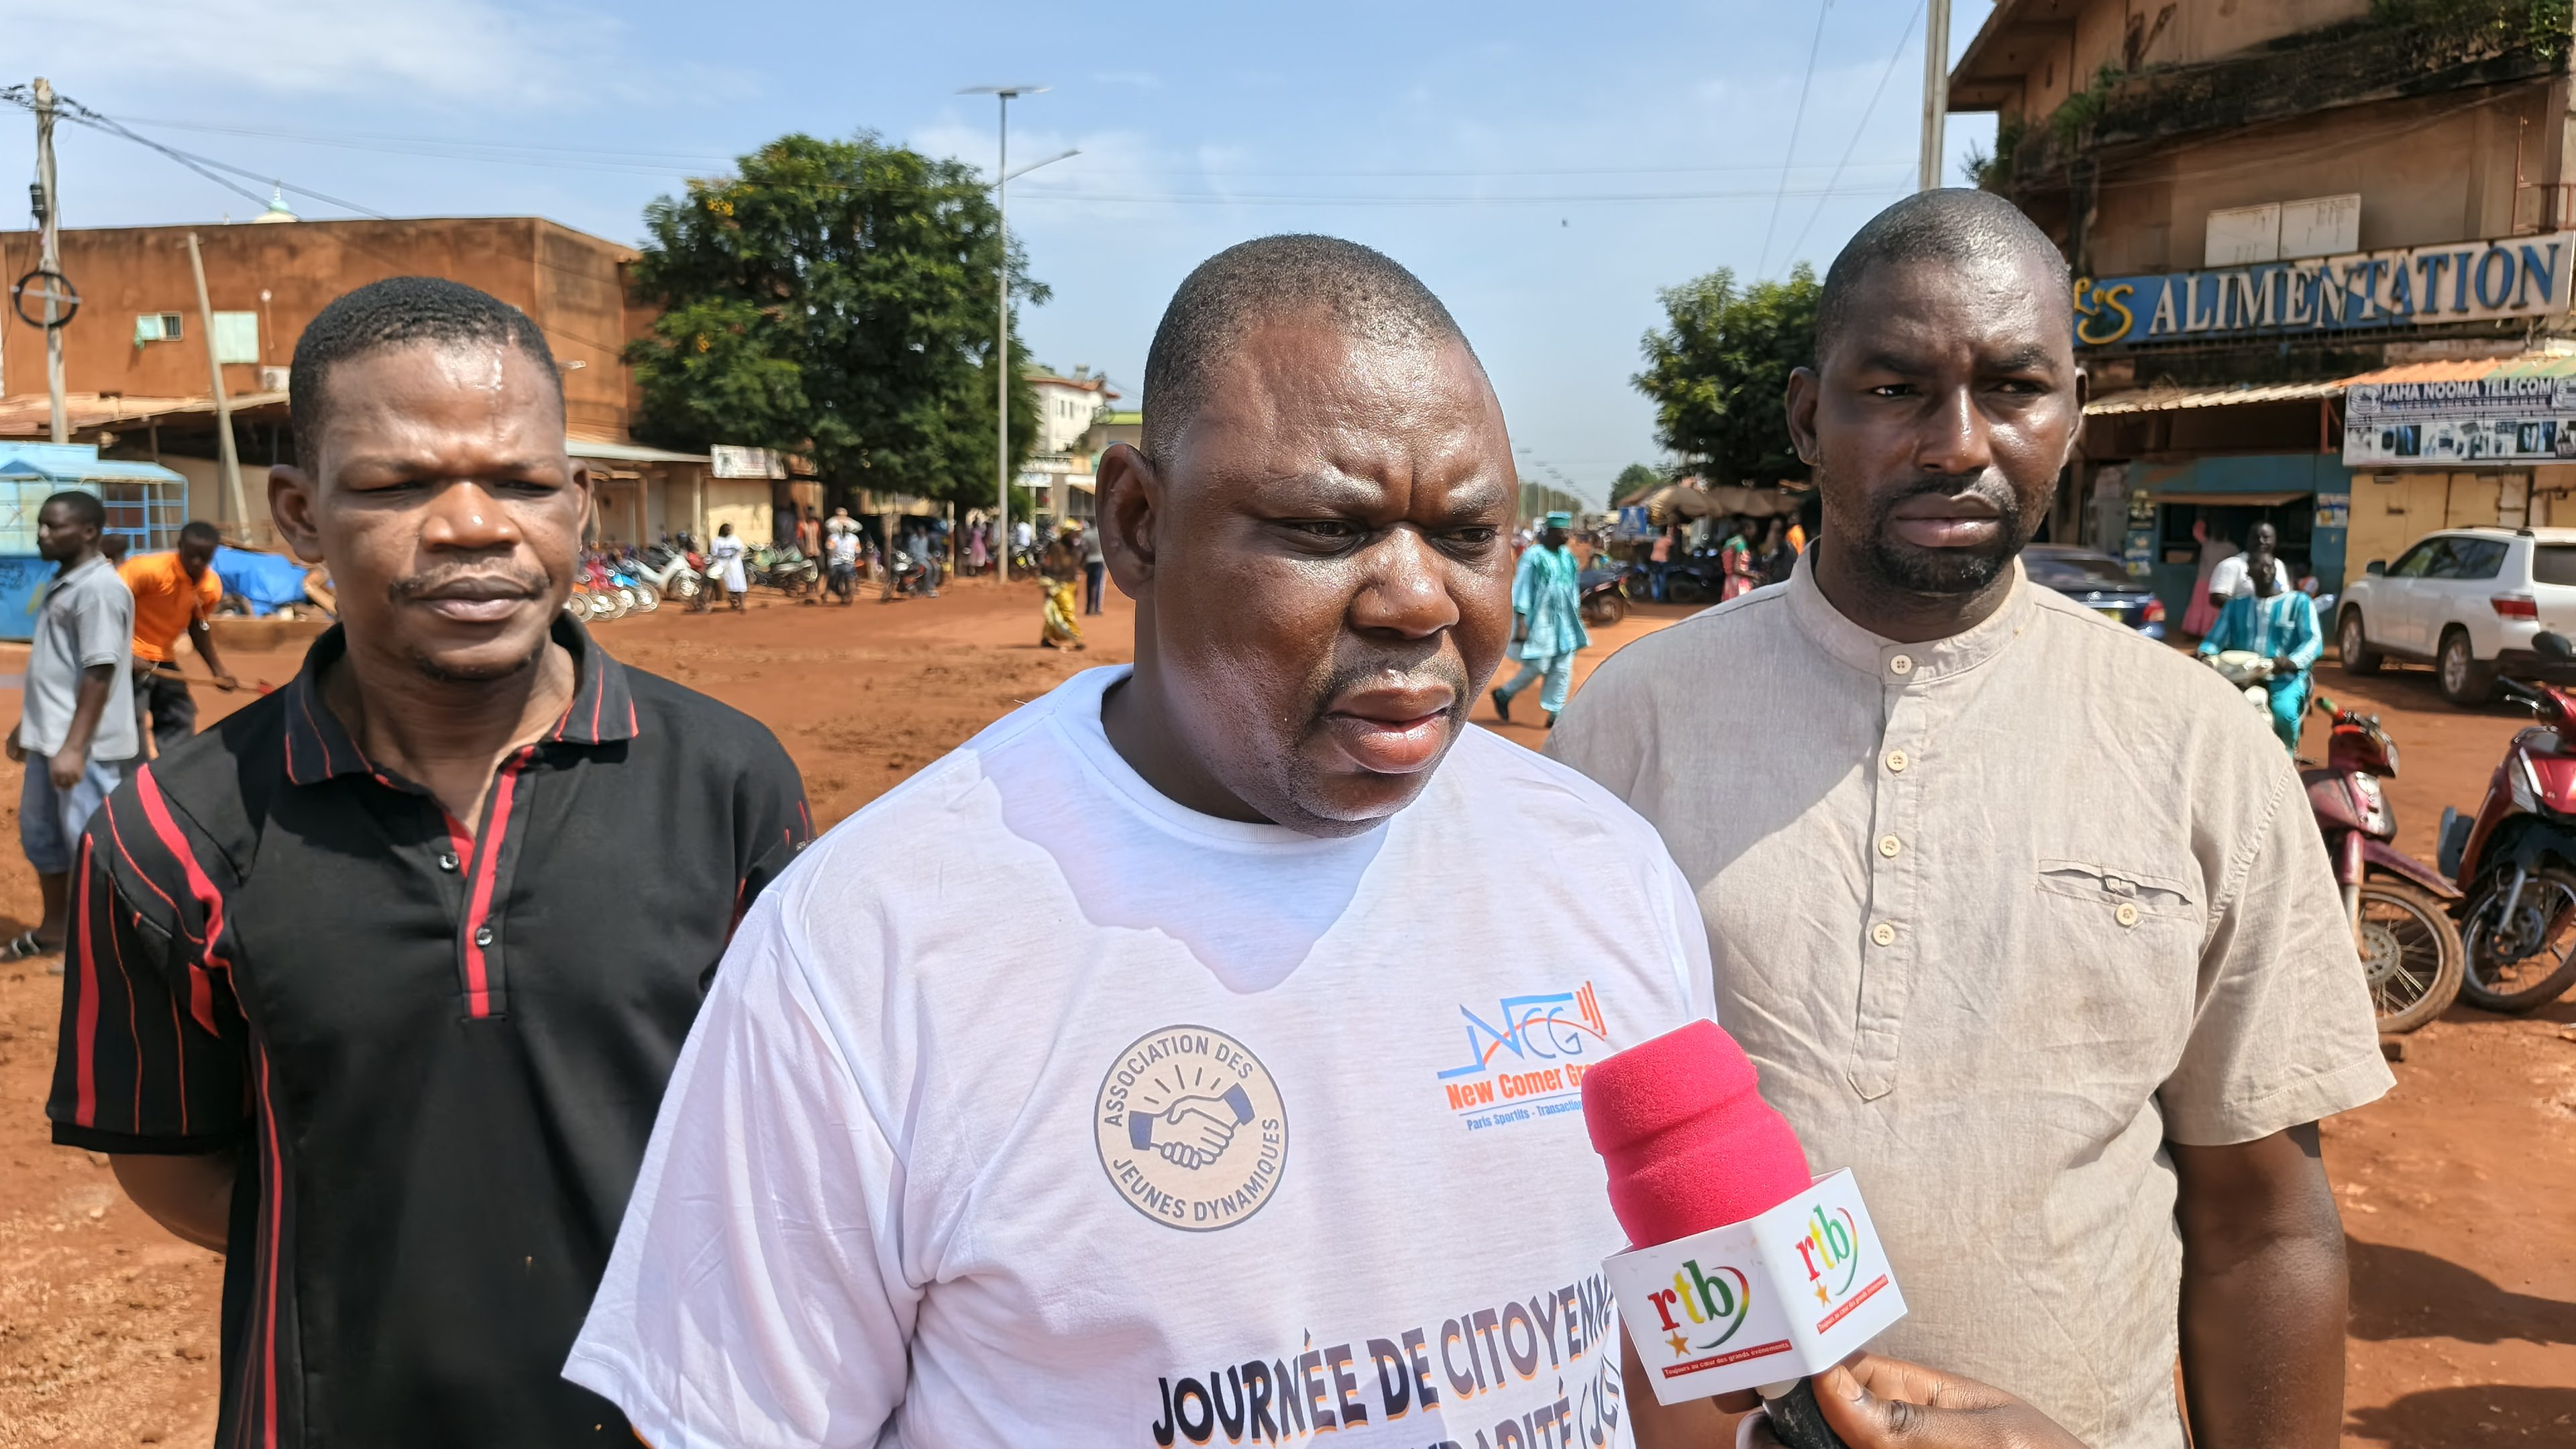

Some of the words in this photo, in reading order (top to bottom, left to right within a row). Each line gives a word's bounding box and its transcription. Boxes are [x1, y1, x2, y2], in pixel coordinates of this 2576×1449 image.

[2149, 243, 2561, 334] ALIMENTATION
[1104, 1034, 1209, 1127] ASSOCIATION
[1215, 1042, 1253, 1079] DES
[1446, 1080, 1494, 1110] New
[1499, 1068, 1563, 1098] Comer
[1466, 1116, 1492, 1131] Paris
[1493, 1108, 1530, 1126] Sportifs
[1113, 1159, 1186, 1218] JEUNES
[1194, 1118, 1280, 1221] DYNAMIQUES
[1795, 1203, 1850, 1282] rtb
[1648, 1260, 1734, 1332] rtb
[1152, 1327, 1368, 1448] JOURNÉE
[1366, 1327, 1440, 1421] DE
[1664, 1366, 1690, 1375] Toujours
[1728, 1351, 1750, 1362] grands
